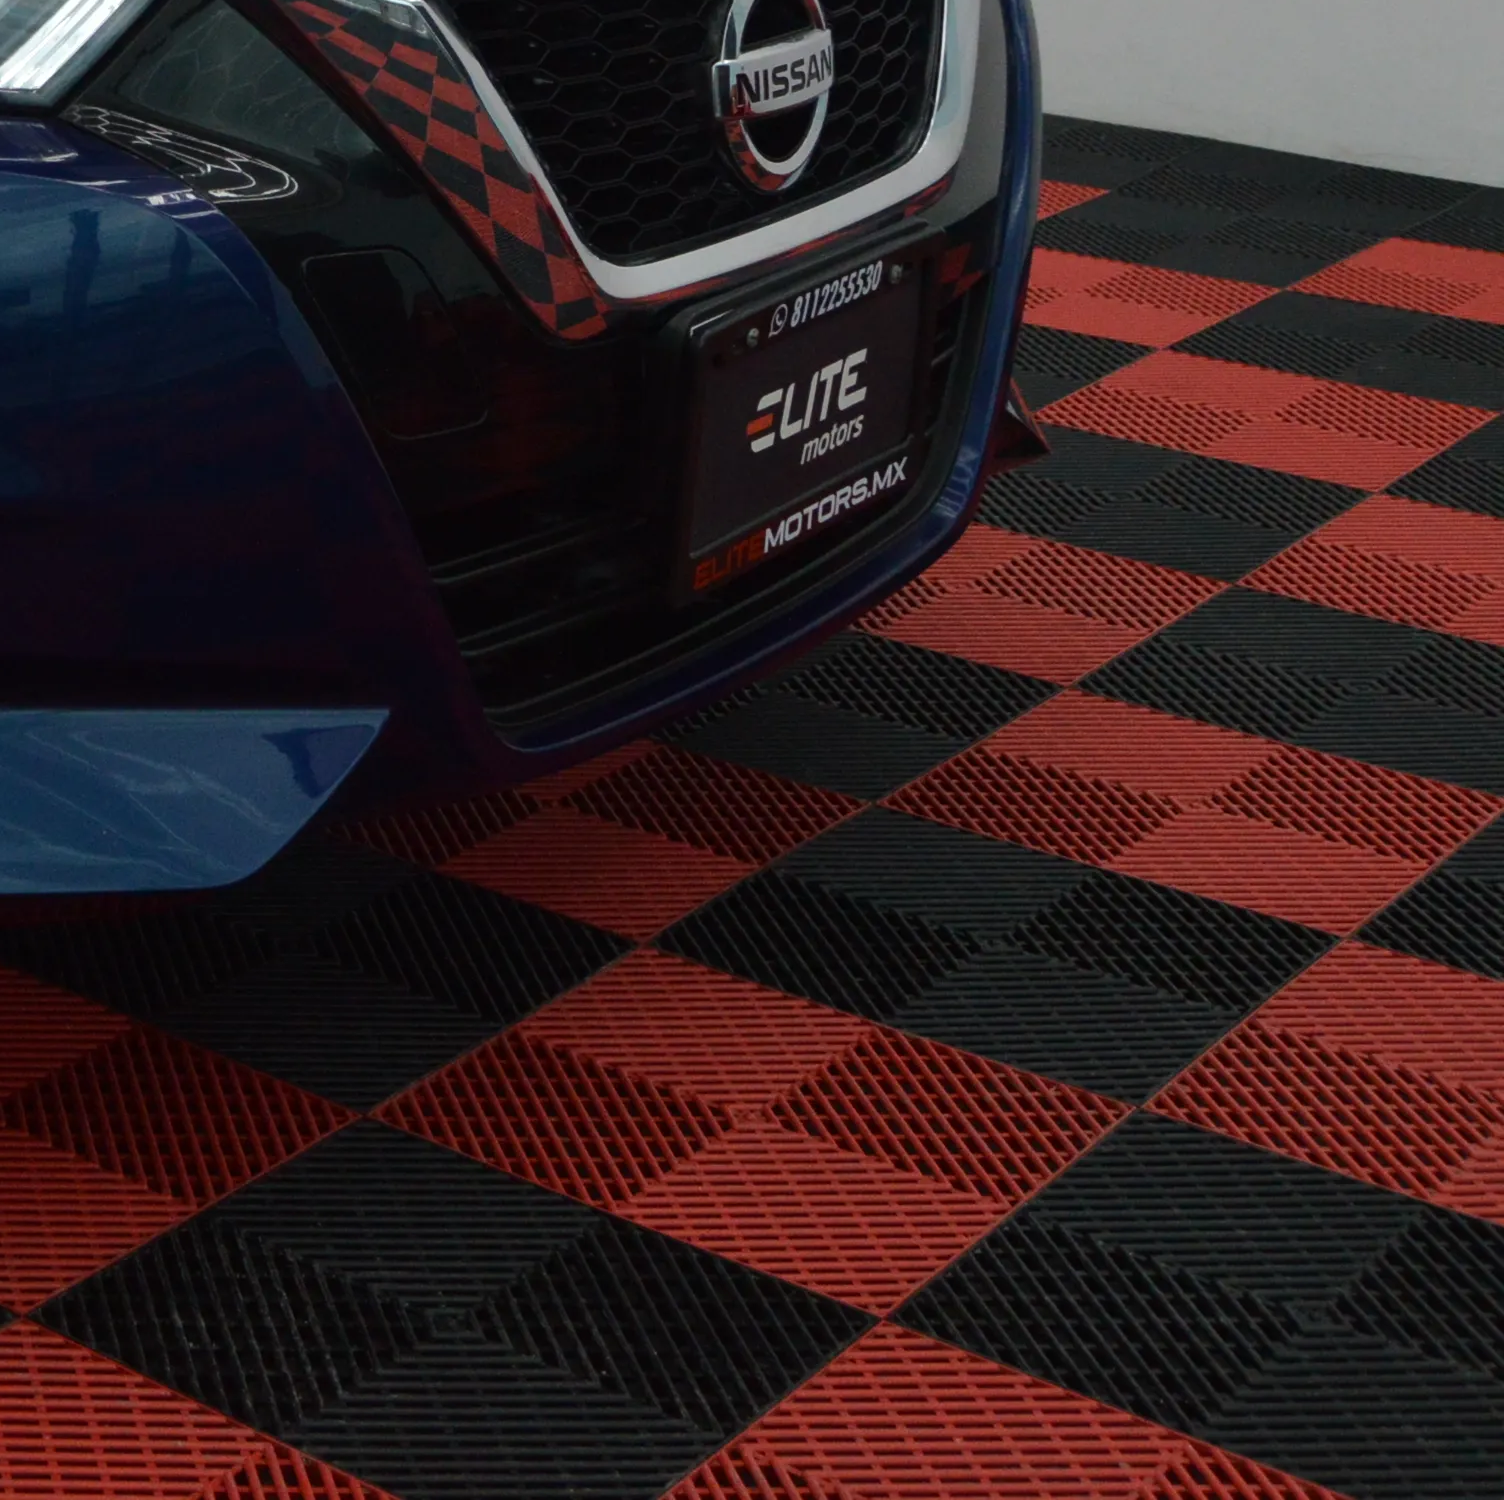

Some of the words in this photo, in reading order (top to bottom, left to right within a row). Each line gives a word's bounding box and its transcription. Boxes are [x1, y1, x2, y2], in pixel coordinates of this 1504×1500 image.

[735, 44, 833, 105] NISSAN
[789, 259, 884, 329] 8112255530
[745, 347, 868, 453] ELITE
[799, 414, 865, 466] motors
